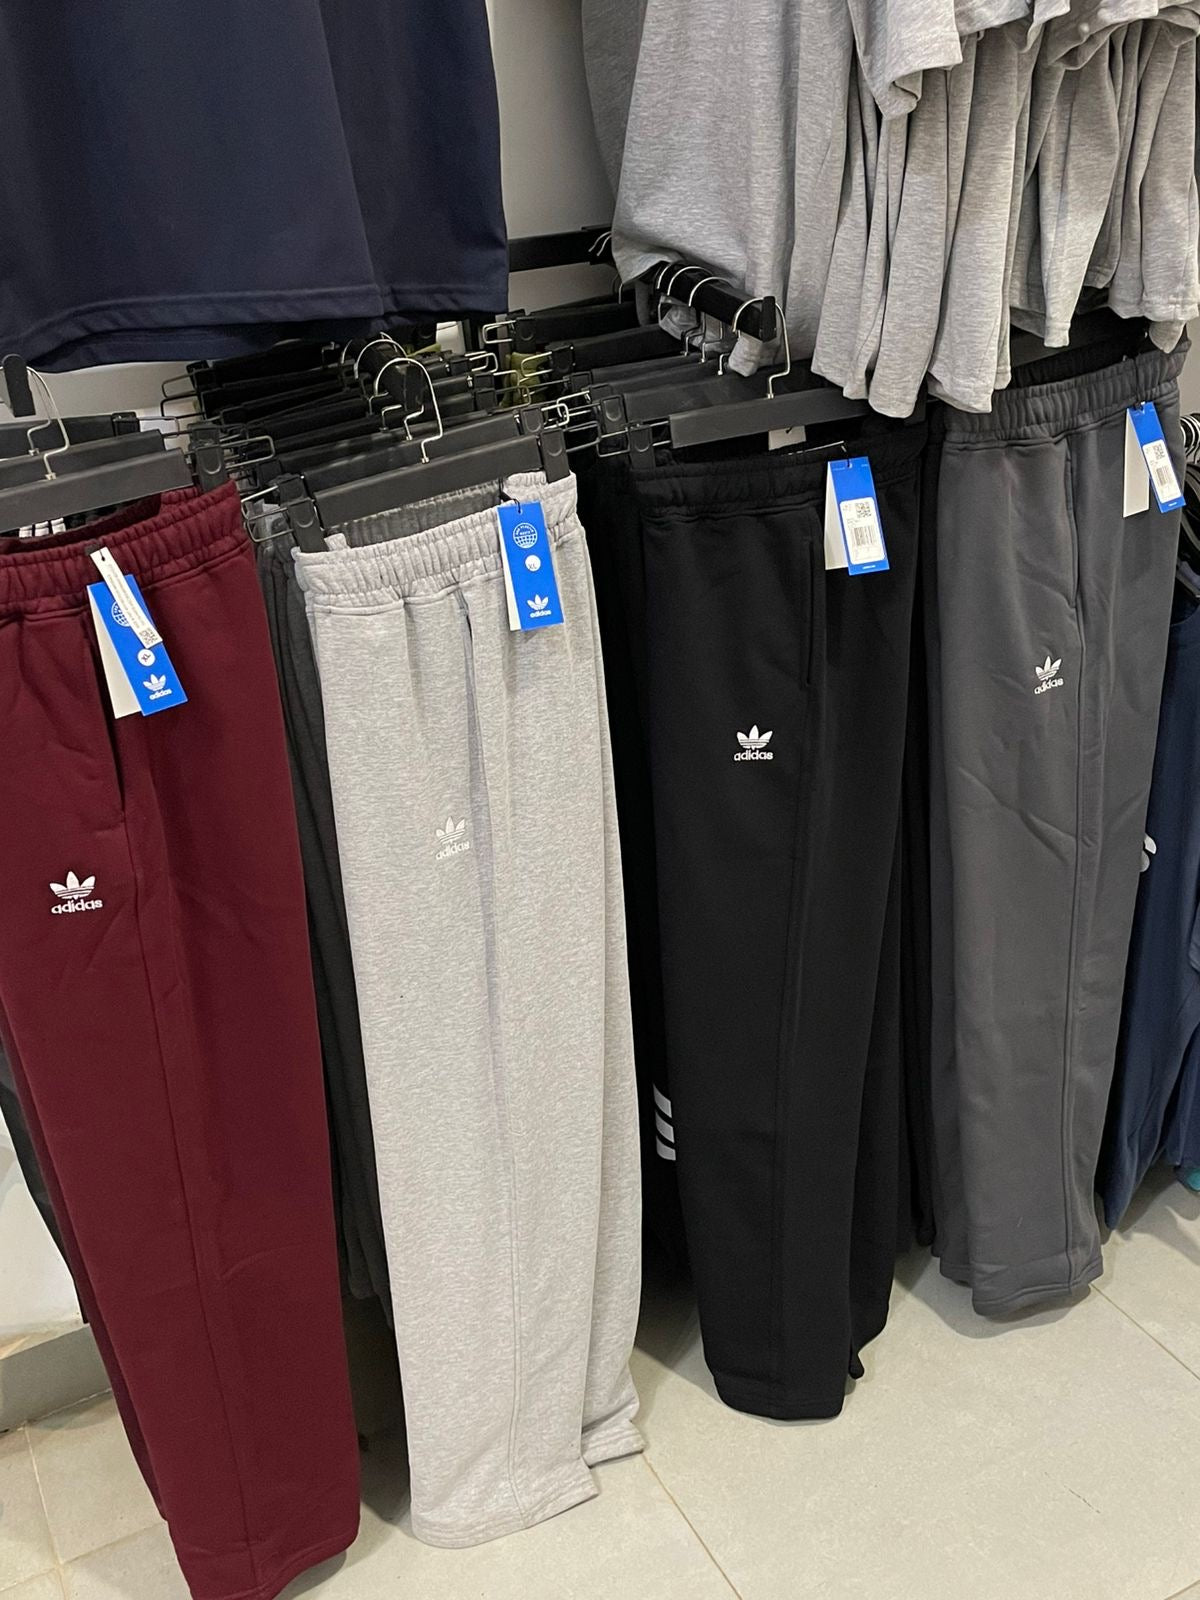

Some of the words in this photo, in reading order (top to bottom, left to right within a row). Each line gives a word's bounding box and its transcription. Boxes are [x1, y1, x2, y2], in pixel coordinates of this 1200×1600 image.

[530, 609, 552, 618] adidas
[1034, 678, 1064, 694] adidas
[733, 749, 774, 761] adidas
[435, 841, 470, 860] adidas
[51, 899, 103, 914] adidas
